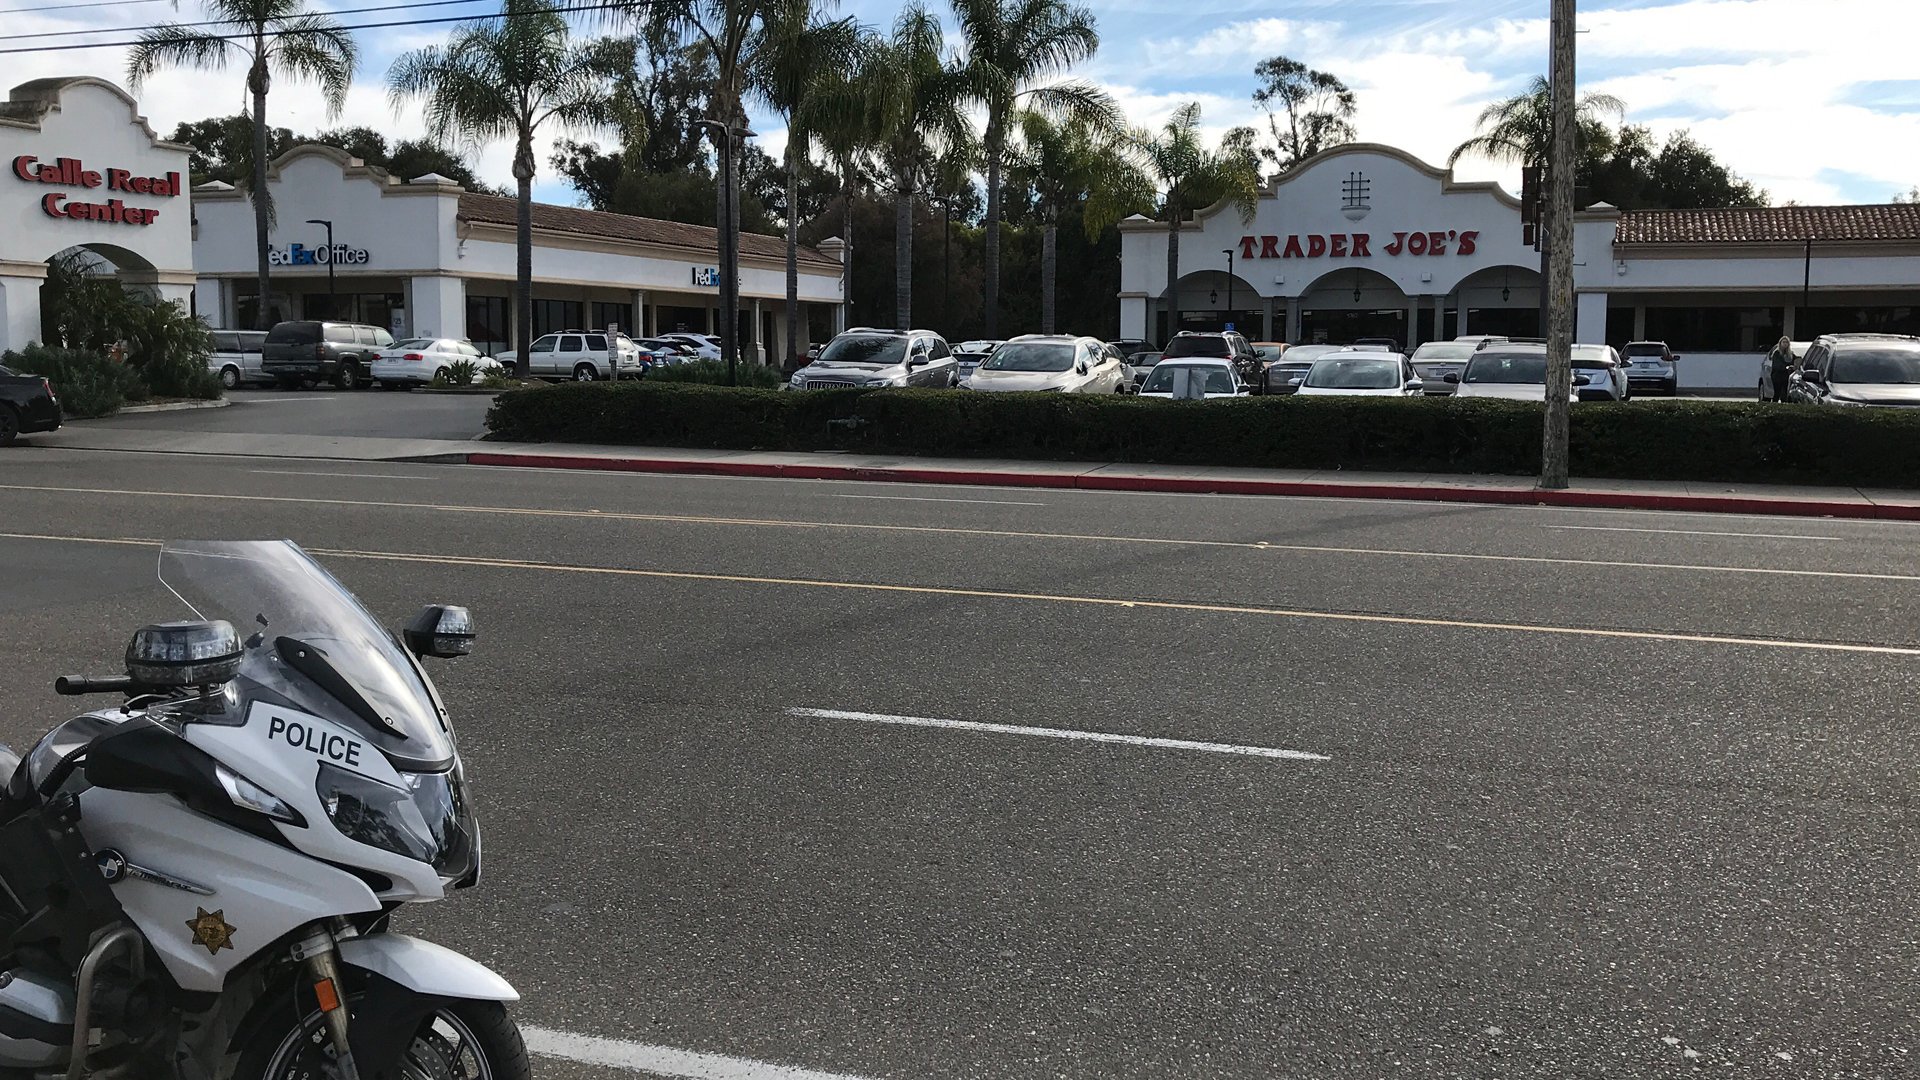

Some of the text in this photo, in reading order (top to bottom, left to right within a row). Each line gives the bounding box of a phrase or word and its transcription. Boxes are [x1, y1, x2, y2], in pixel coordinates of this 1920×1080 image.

[12, 155, 181, 197] Calle Real
[42, 192, 160, 226] Center
[1238, 229, 1480, 259] TRADER JOE'S
[268, 716, 362, 767] POLICE
